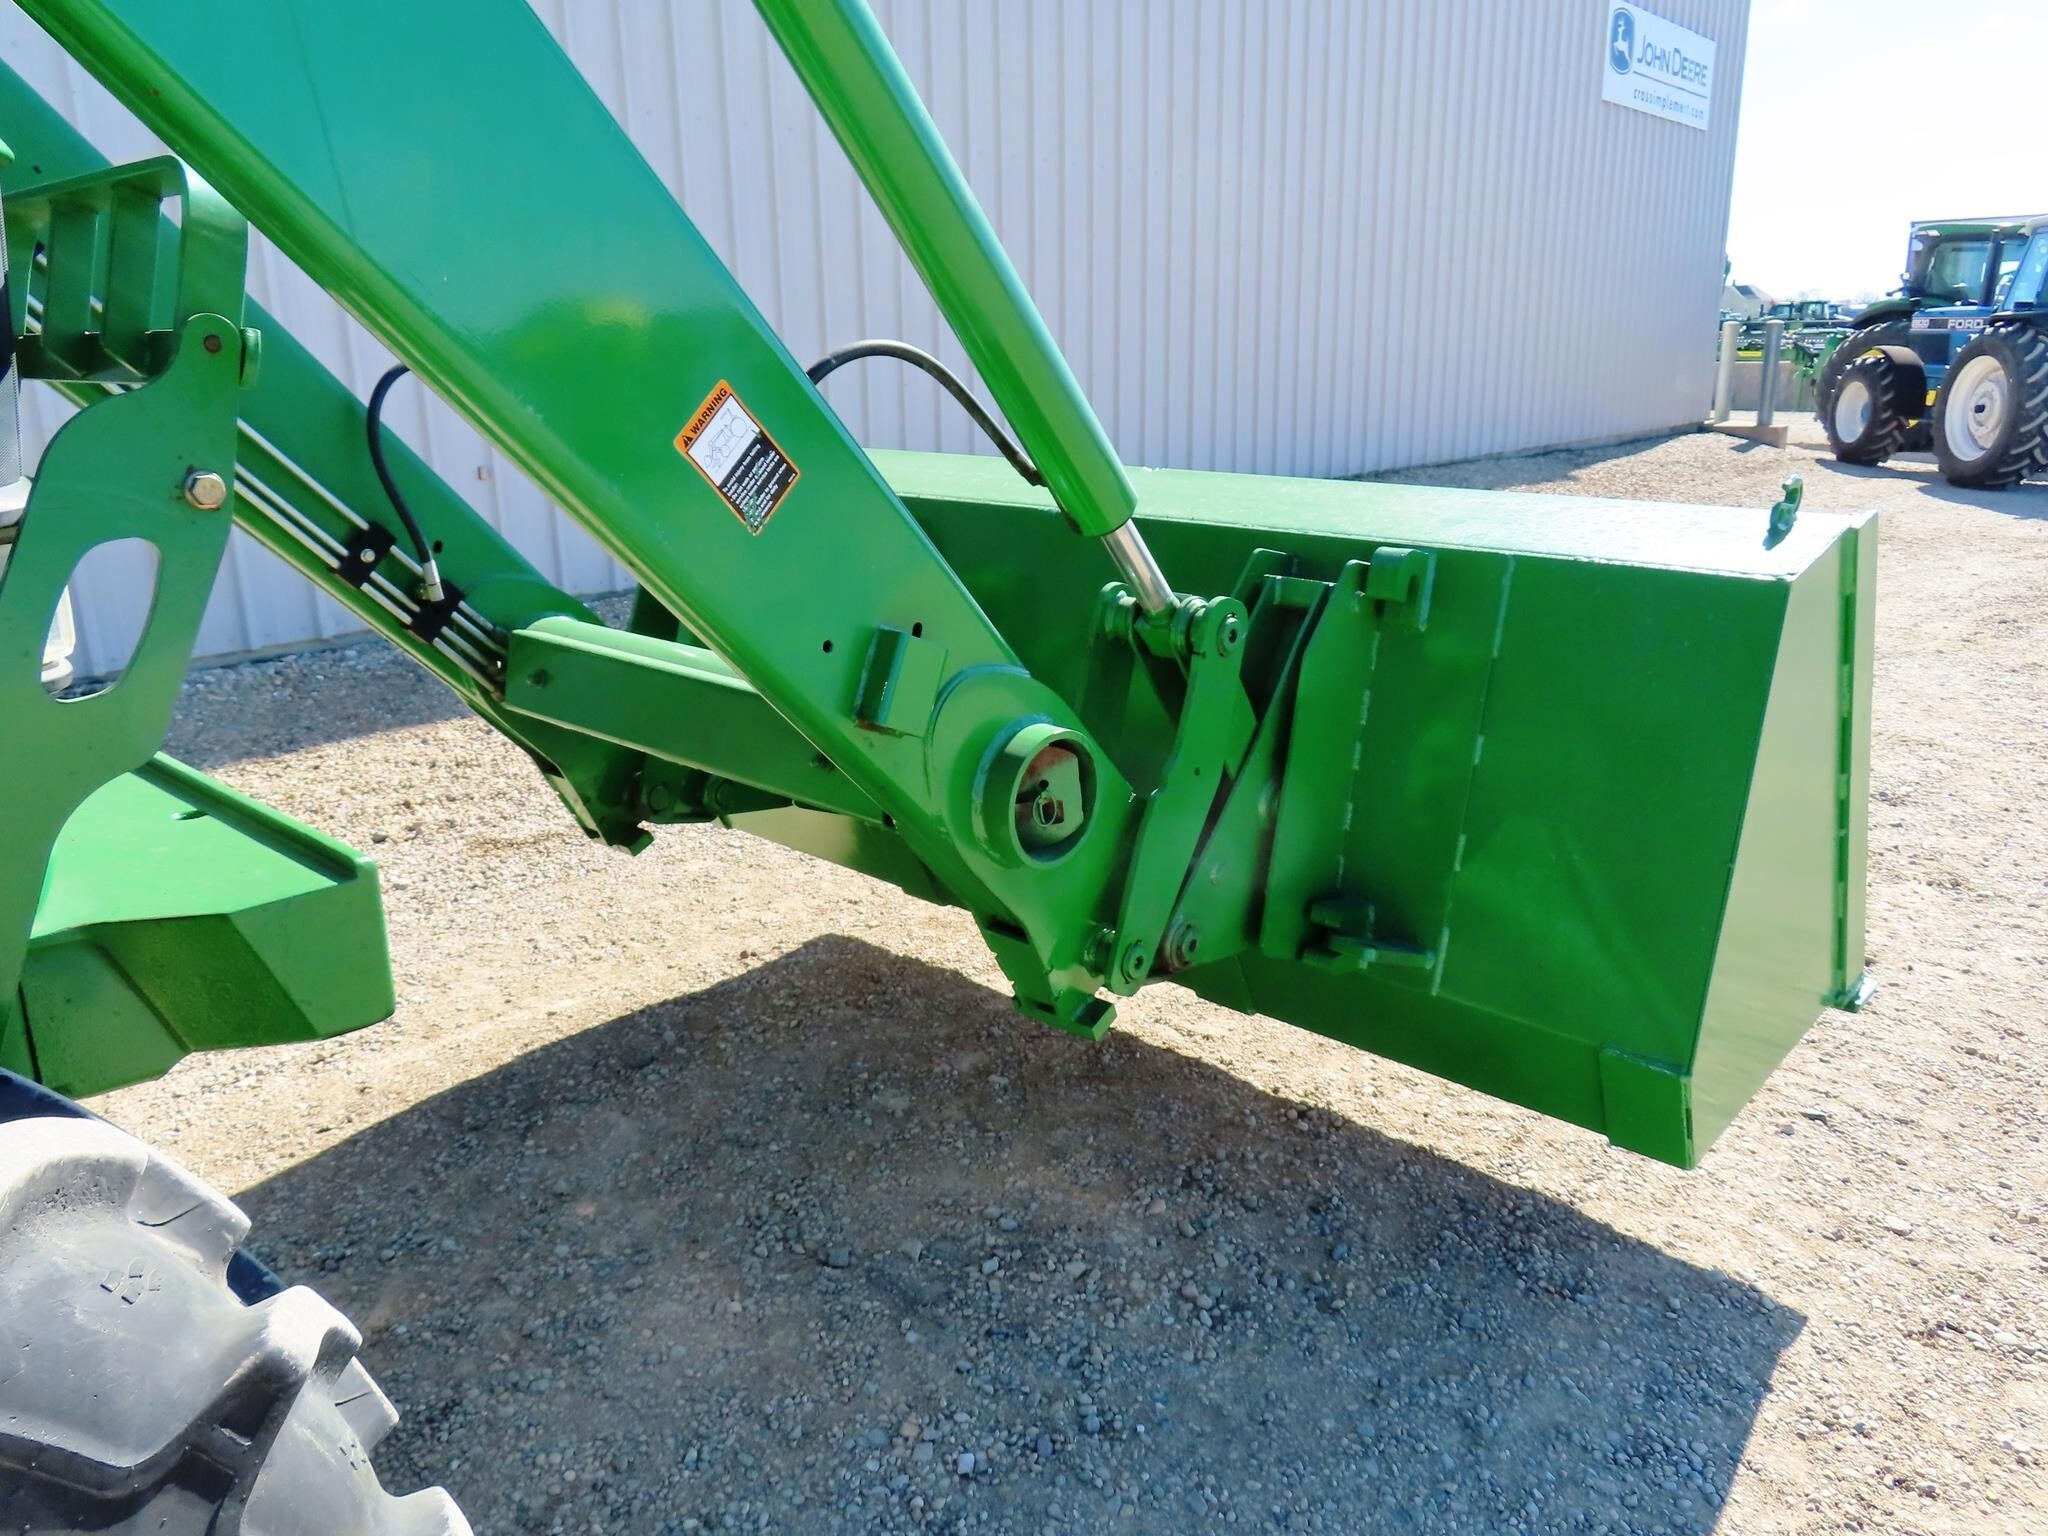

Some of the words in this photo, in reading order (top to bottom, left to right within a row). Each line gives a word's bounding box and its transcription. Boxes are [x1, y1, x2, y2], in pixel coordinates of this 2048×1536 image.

[1637, 34, 1671, 74] JOHN
[1671, 47, 1708, 87] DEERE
[1947, 319, 1985, 330] FORD
[689, 387, 728, 434] WARNING
